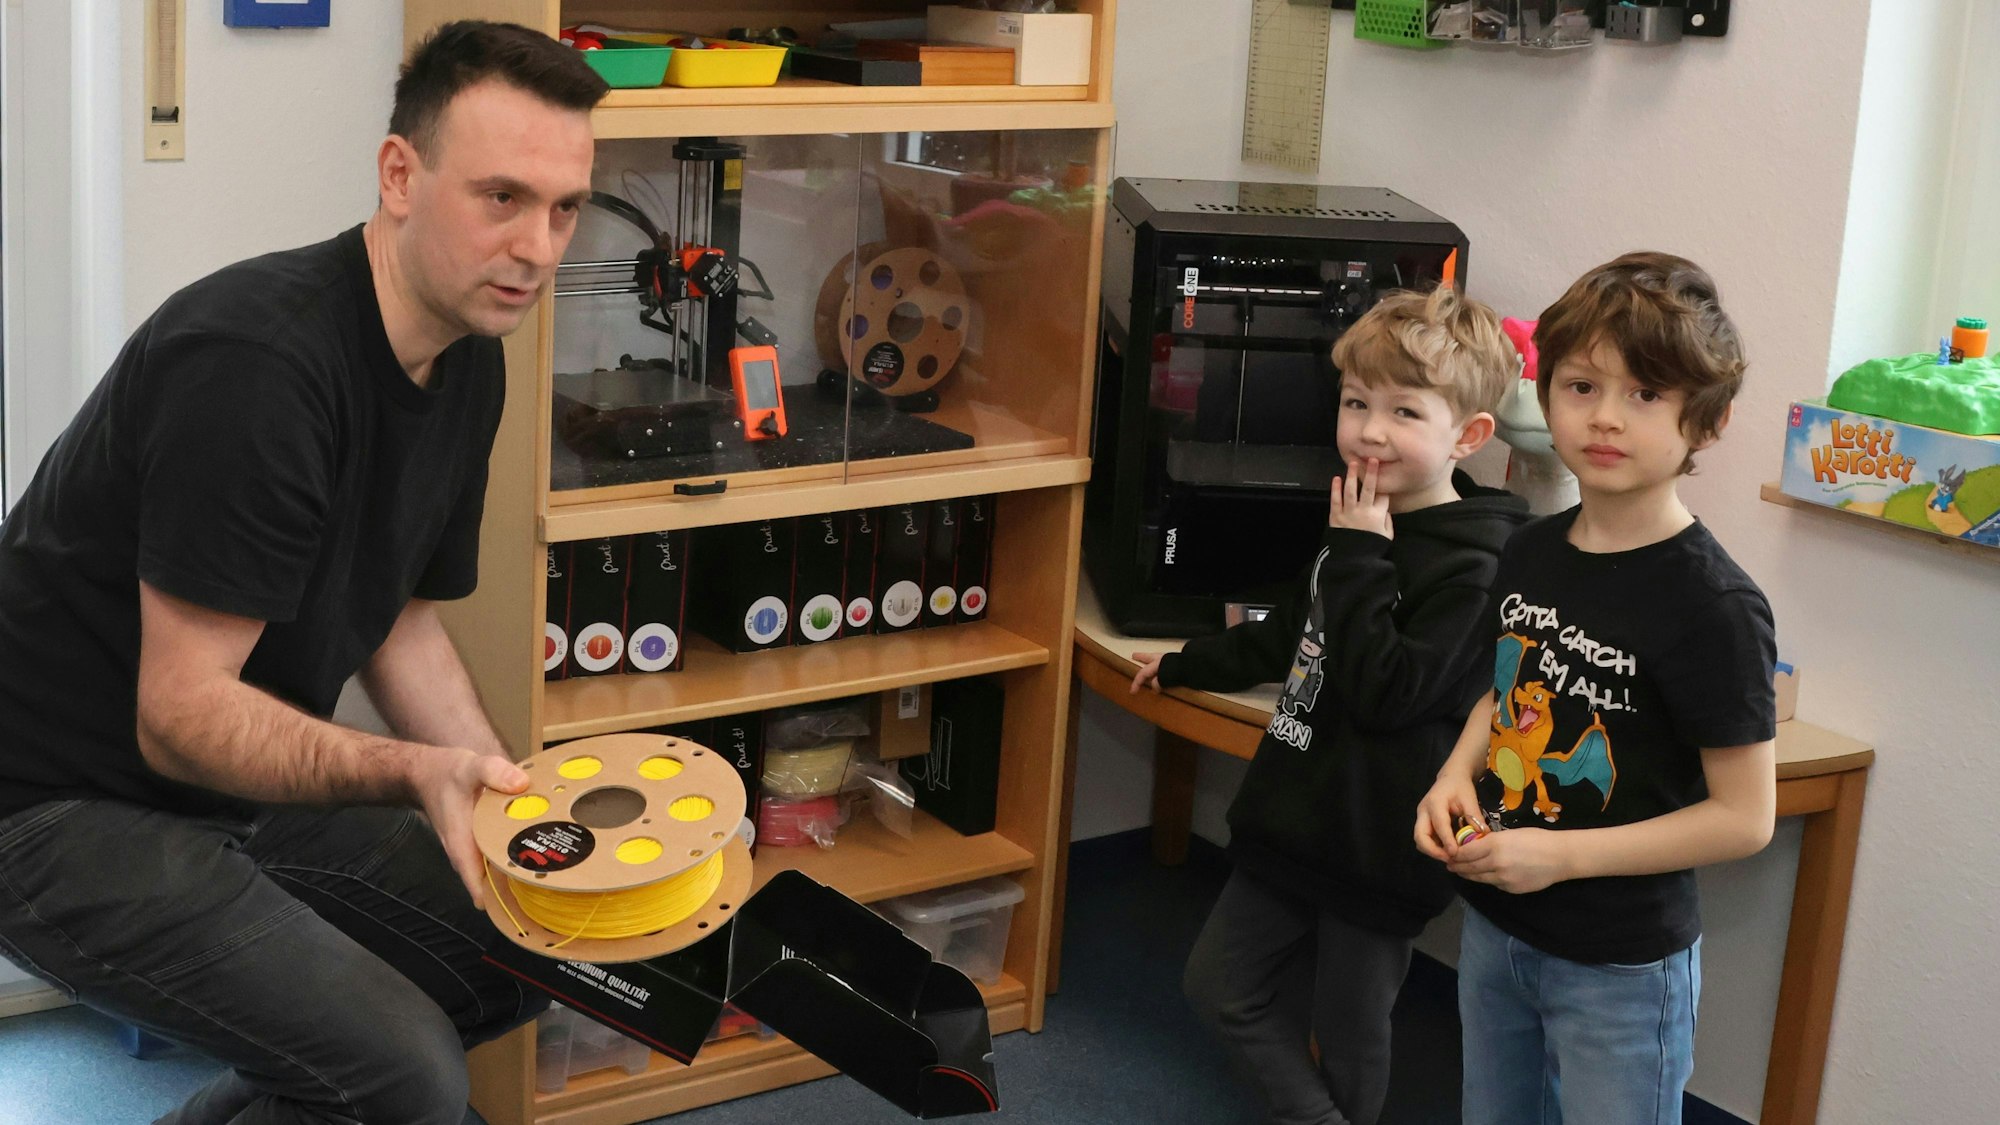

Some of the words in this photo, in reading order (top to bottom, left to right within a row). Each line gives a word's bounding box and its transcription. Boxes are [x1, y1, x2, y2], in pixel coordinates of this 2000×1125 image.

[1185, 269, 1197, 294] ONE
[1183, 296, 1196, 329] CORE
[1831, 418, 1894, 457] Lotti
[1811, 445, 1916, 484] Karotti
[821, 518, 838, 544] print
[901, 509, 918, 535] print
[760, 525, 778, 552] print
[1165, 528, 1177, 564] PRUSA
[598, 544, 619, 573] print
[656, 543, 677, 571] print
[1500, 593, 1559, 631] GOTTA
[1559, 625, 1636, 676] CATCH
[733, 742, 751, 768] print
[606, 975, 651, 1002] QUALITÄT
